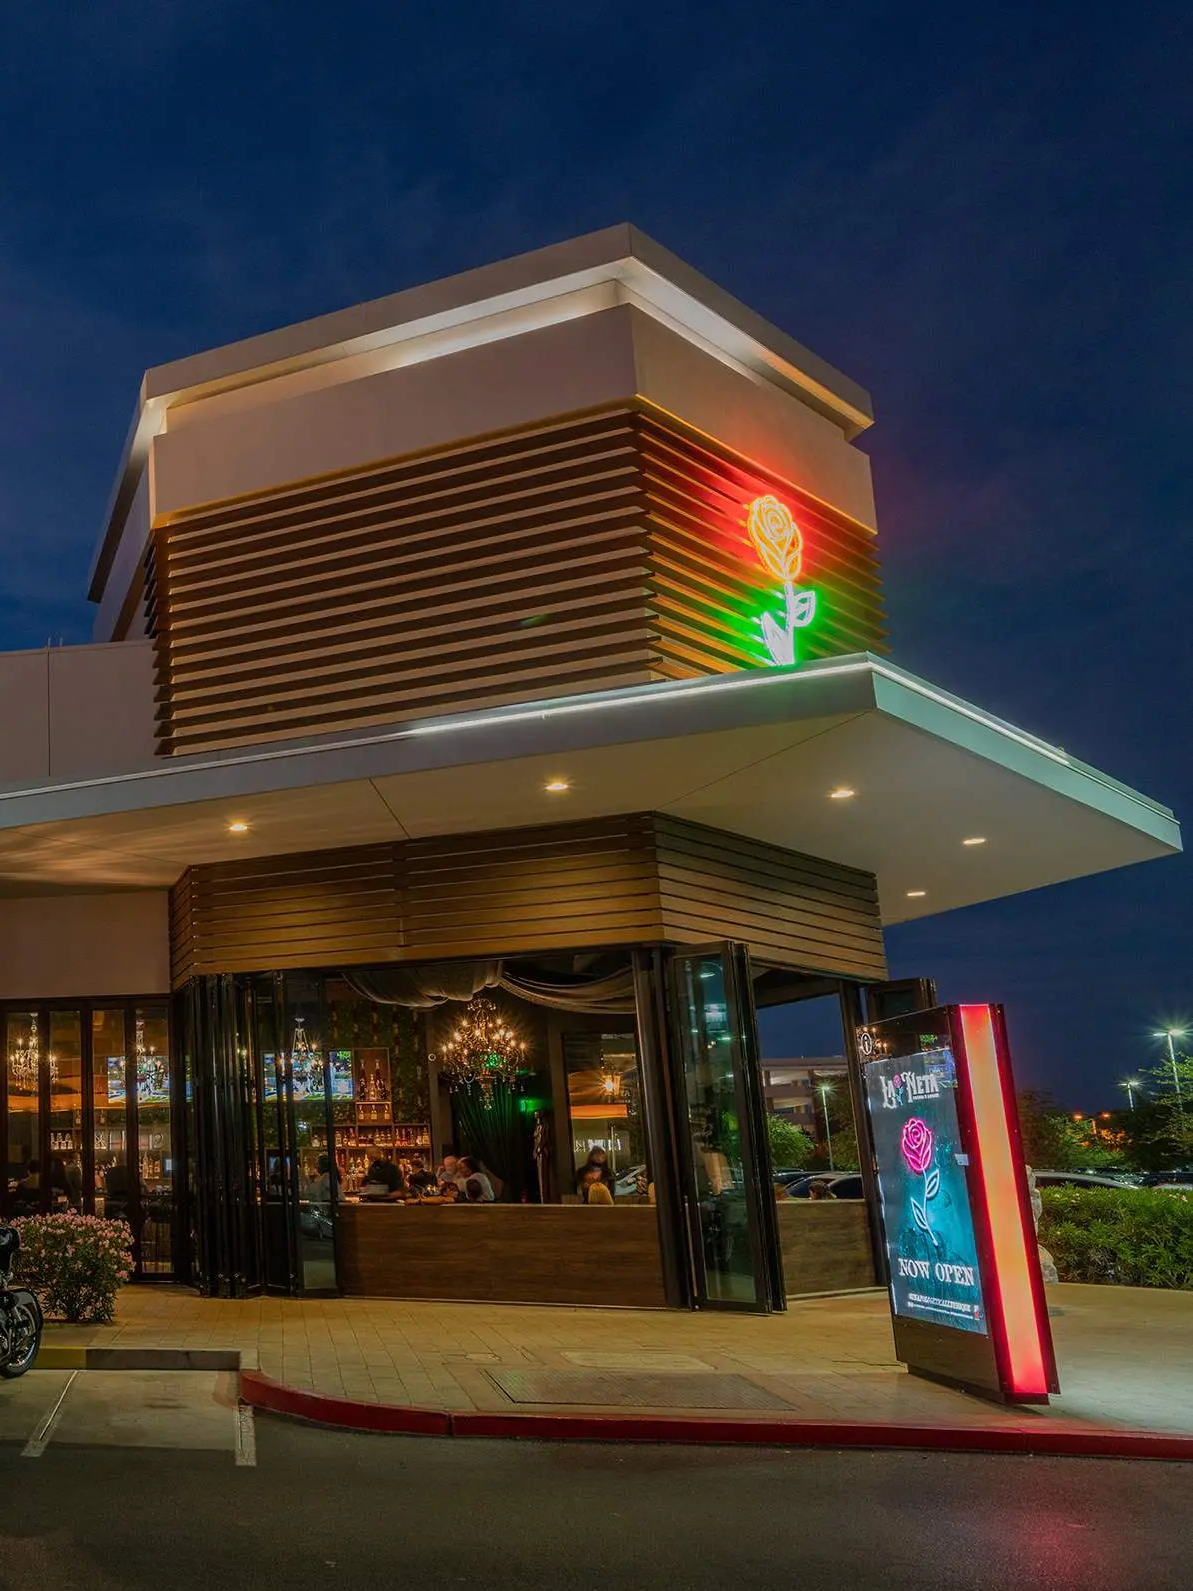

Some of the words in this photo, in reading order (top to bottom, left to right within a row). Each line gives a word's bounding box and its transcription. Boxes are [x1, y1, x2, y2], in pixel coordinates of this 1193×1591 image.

[879, 1075, 897, 1109] LA
[900, 1070, 939, 1103] NETA
[898, 1258, 930, 1280] NOW
[934, 1262, 975, 1286] OPEN
